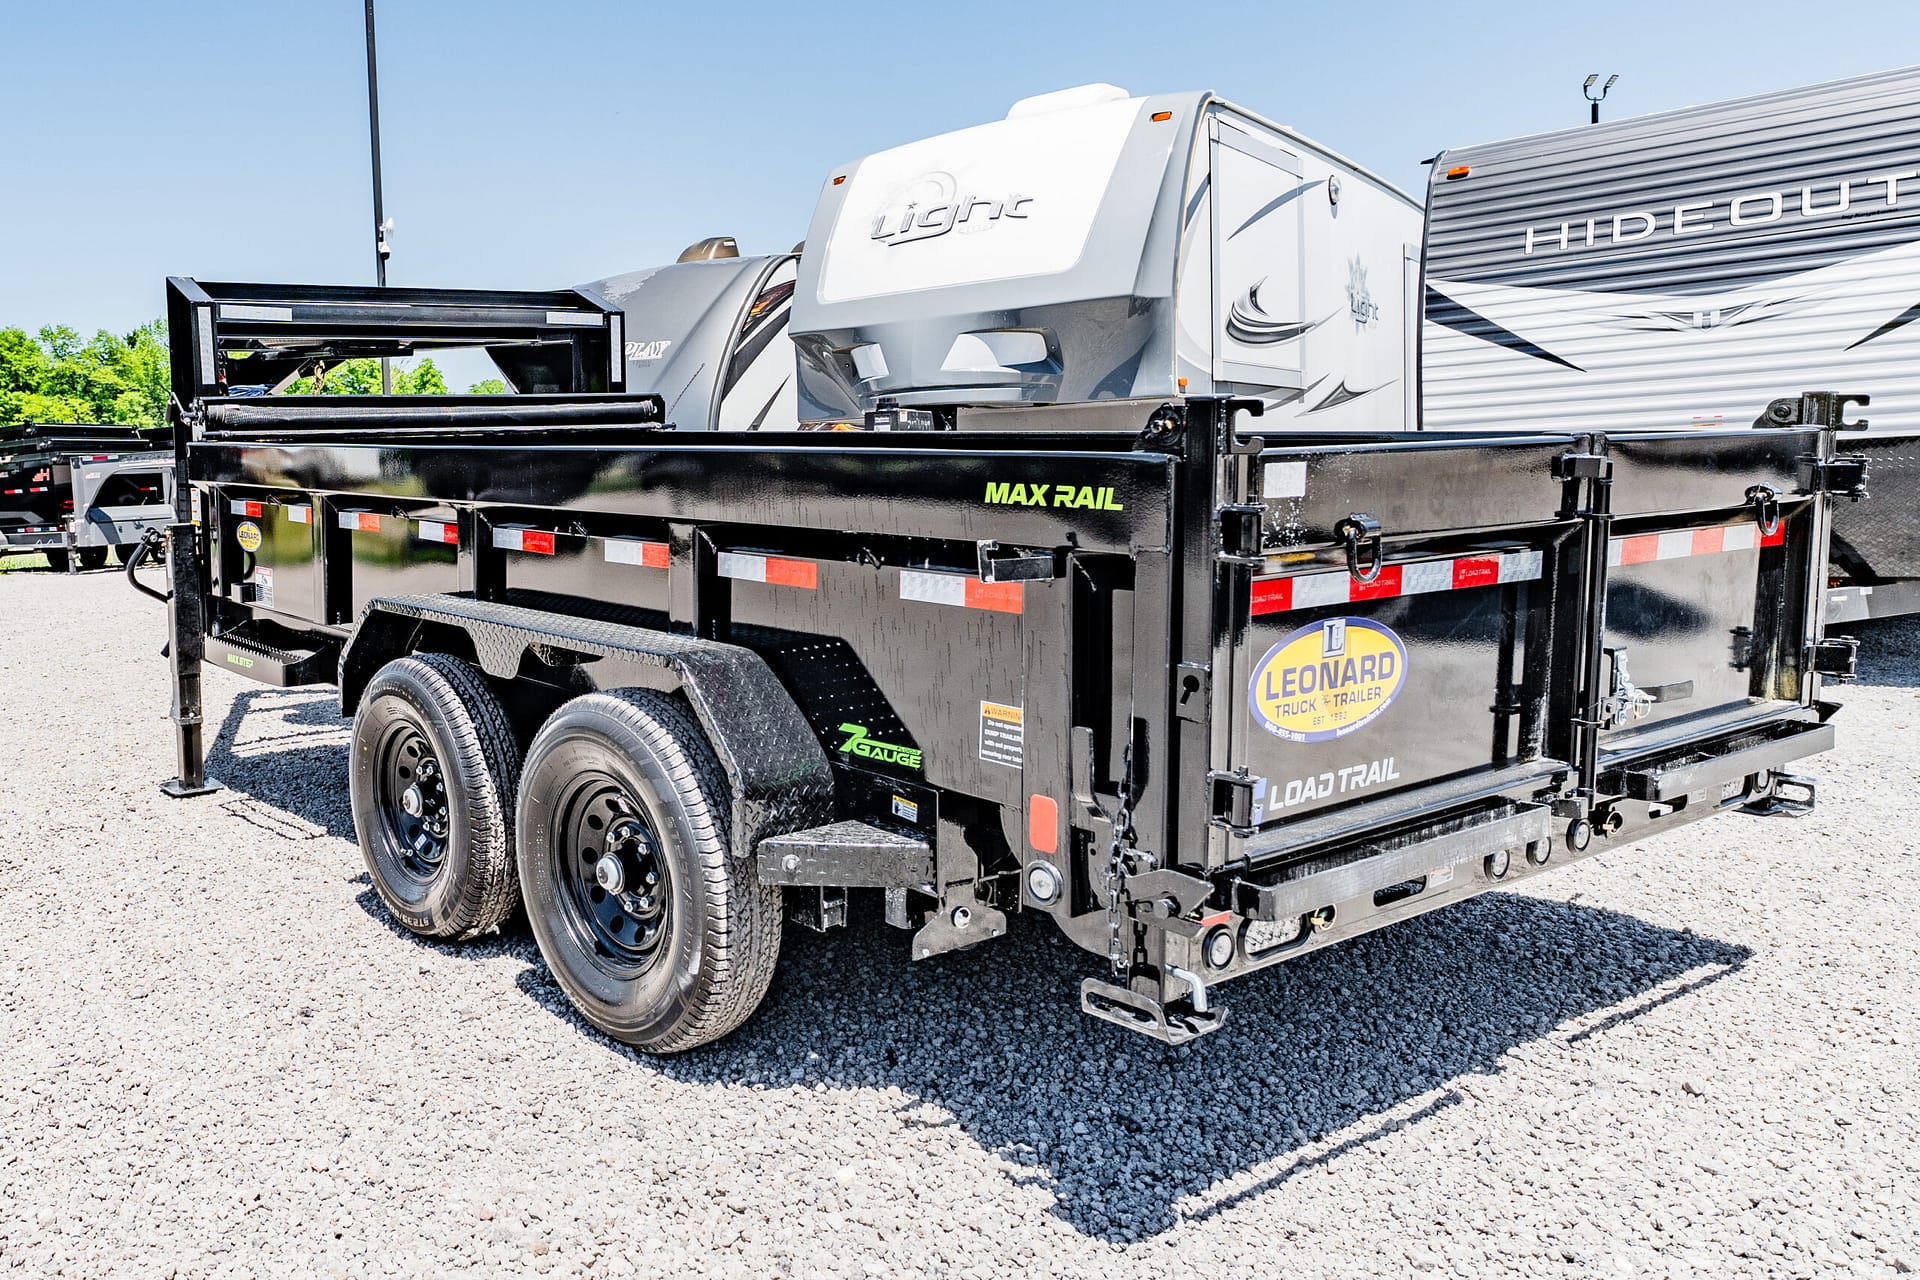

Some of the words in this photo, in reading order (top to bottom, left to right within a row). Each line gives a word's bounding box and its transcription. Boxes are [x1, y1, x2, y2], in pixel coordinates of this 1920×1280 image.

[1523, 170, 1920, 256] HIDEOUT
[984, 482, 1050, 507] MAX
[1053, 485, 1124, 511] RAIL
[1265, 651, 1396, 701] LEONARD
[1275, 697, 1317, 719] TRUCK
[1333, 686, 1382, 708] TRAILER
[851, 738, 922, 769] GAUGE
[1269, 772, 1335, 812] LOAD
[1337, 756, 1401, 794] TRAIL
